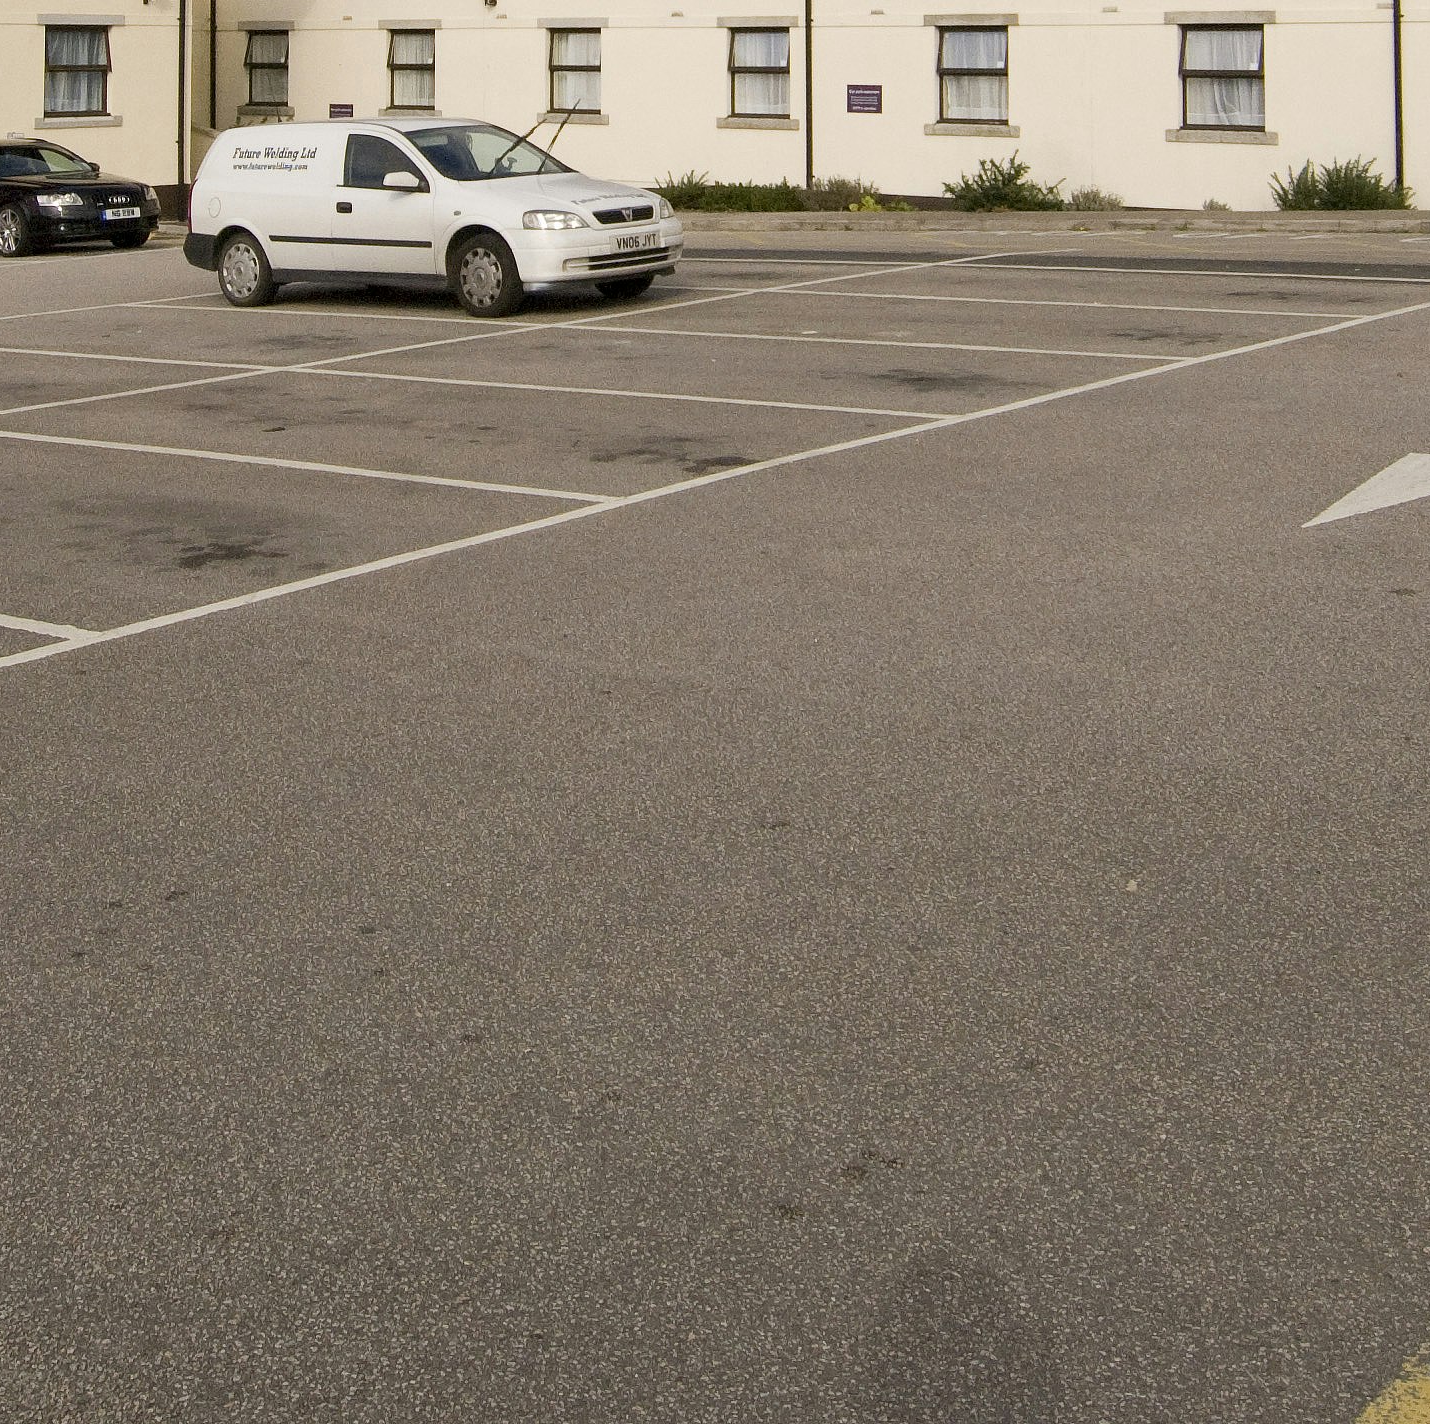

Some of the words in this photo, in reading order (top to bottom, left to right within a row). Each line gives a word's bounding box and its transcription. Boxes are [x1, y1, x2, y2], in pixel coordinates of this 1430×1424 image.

[232, 147, 261, 159] Future
[264, 147, 299, 162] Welding
[300, 147, 318, 159] Ltd
[616, 236, 640, 249] VN06
[642, 233, 657, 247] JYT
